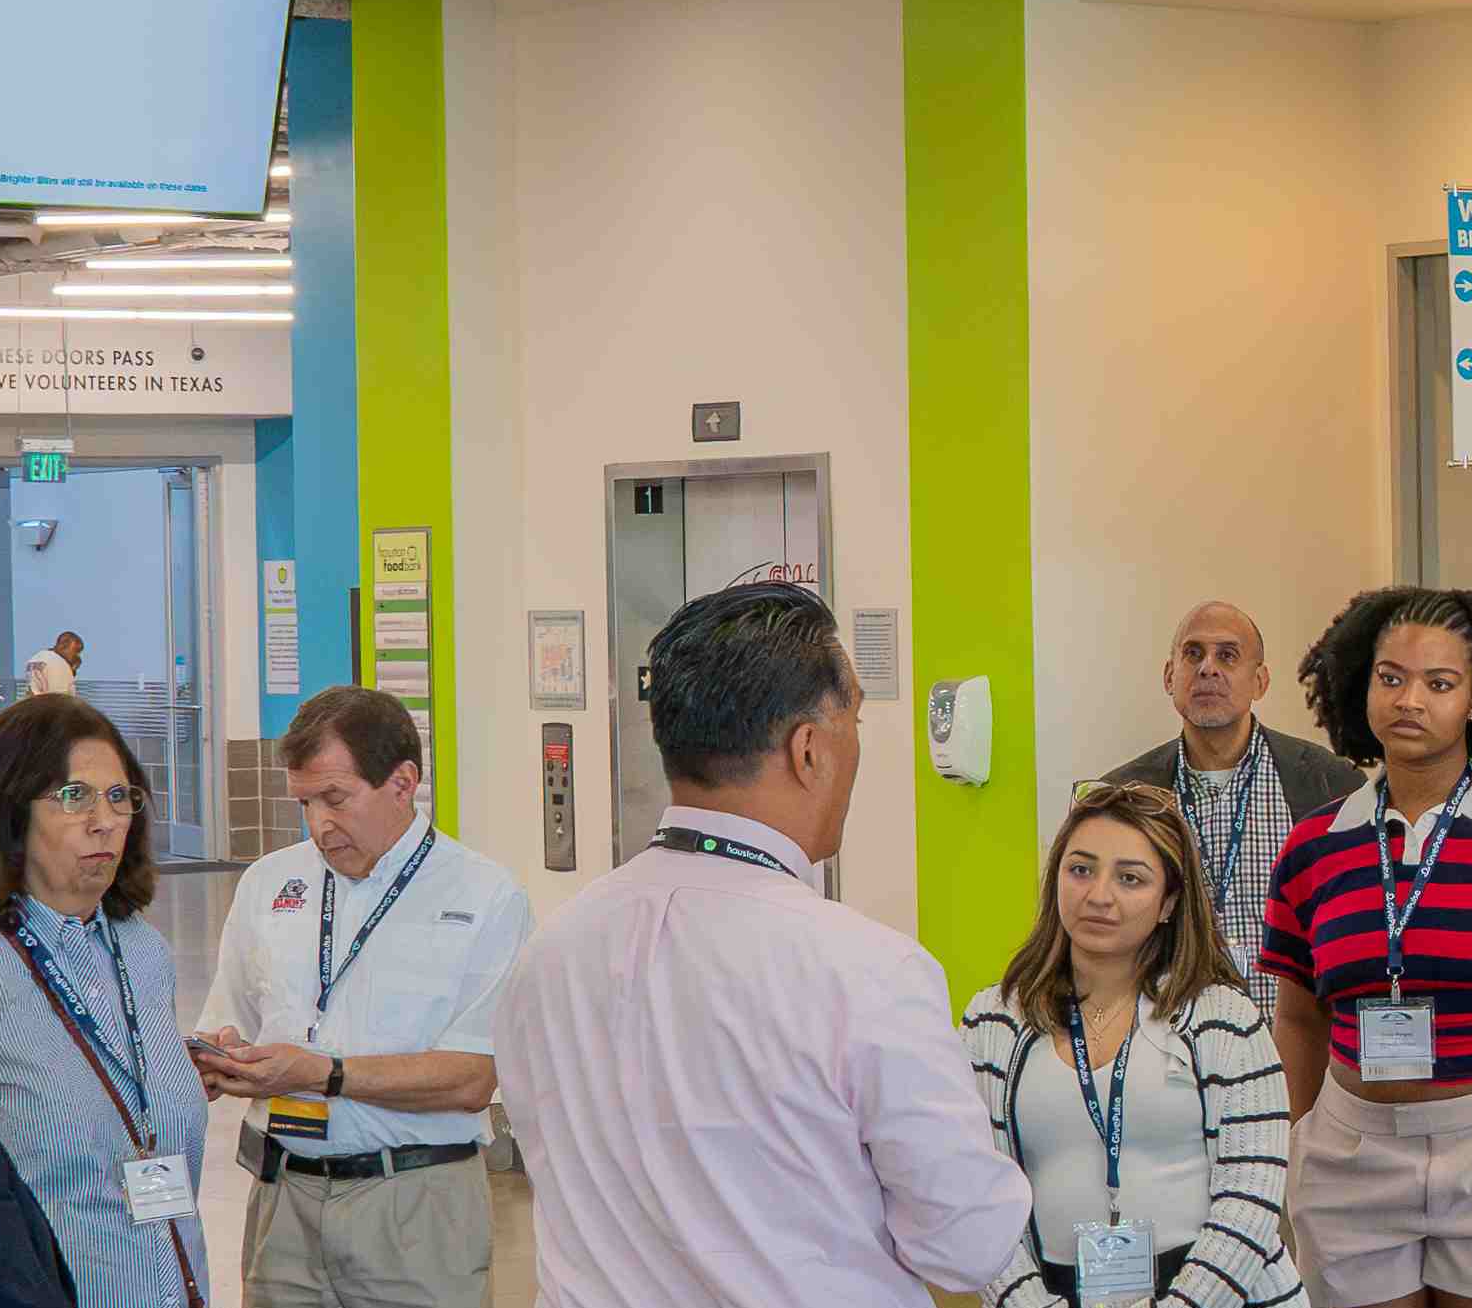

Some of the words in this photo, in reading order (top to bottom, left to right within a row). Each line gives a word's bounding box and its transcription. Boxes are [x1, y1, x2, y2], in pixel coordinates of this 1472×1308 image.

[42, 349, 105, 366] DOORS
[113, 350, 155, 367] PASS
[24, 374, 137, 391] VOLUNTEERS
[145, 376, 163, 391] IN
[171, 377, 224, 392] TEXAS
[31, 454, 62, 482] EXIT
[644, 485, 652, 514] 1
